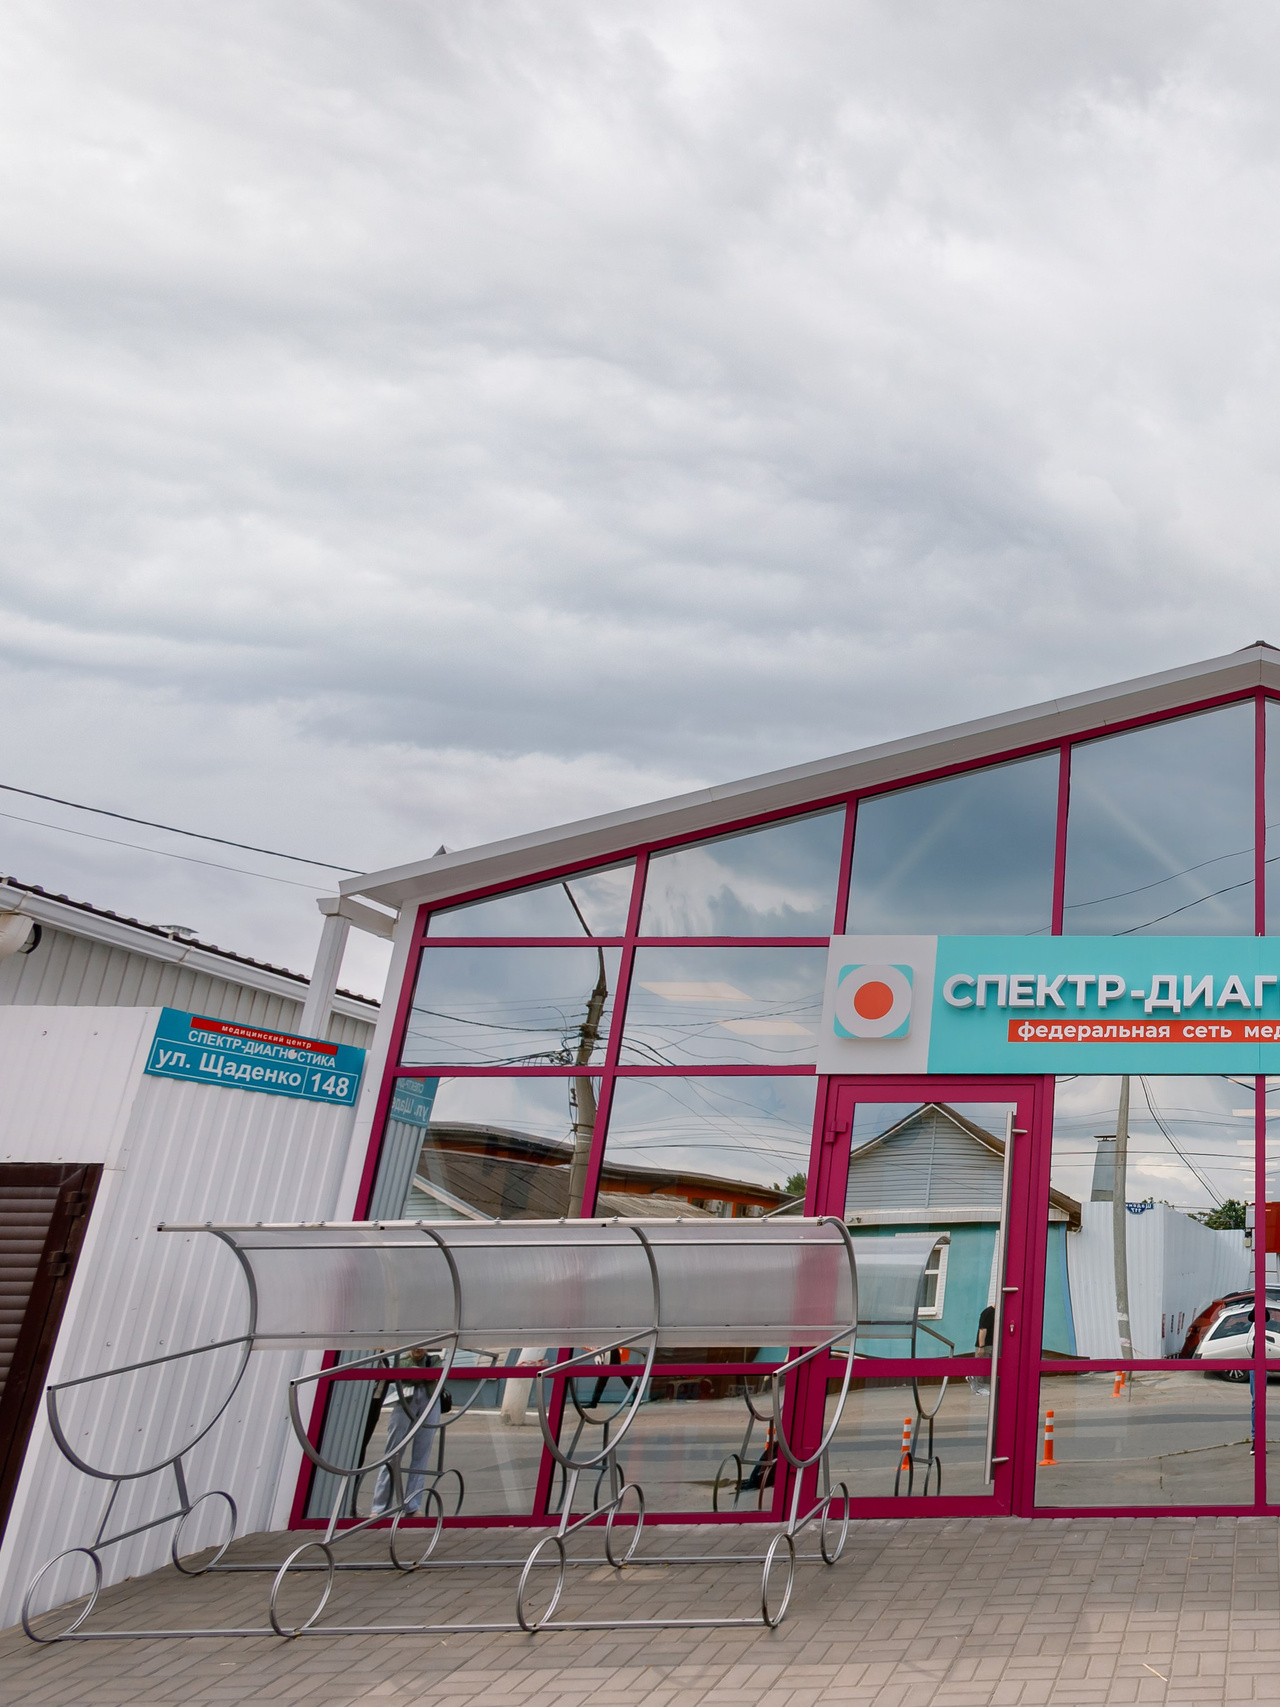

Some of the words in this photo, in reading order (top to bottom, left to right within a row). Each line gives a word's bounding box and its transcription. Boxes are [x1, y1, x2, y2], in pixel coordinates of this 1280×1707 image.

[221, 1024, 284, 1043] медицинский
[286, 1037, 312, 1049] центр
[1017, 1021, 1171, 1043] федеральная
[1182, 1025, 1234, 1039] сеть
[188, 1030, 336, 1068] СПЕКТР-ДИАГНОСТИКА
[155, 1049, 191, 1069] ул.
[199, 1053, 302, 1087] Щаденко
[310, 1073, 350, 1097] 148
